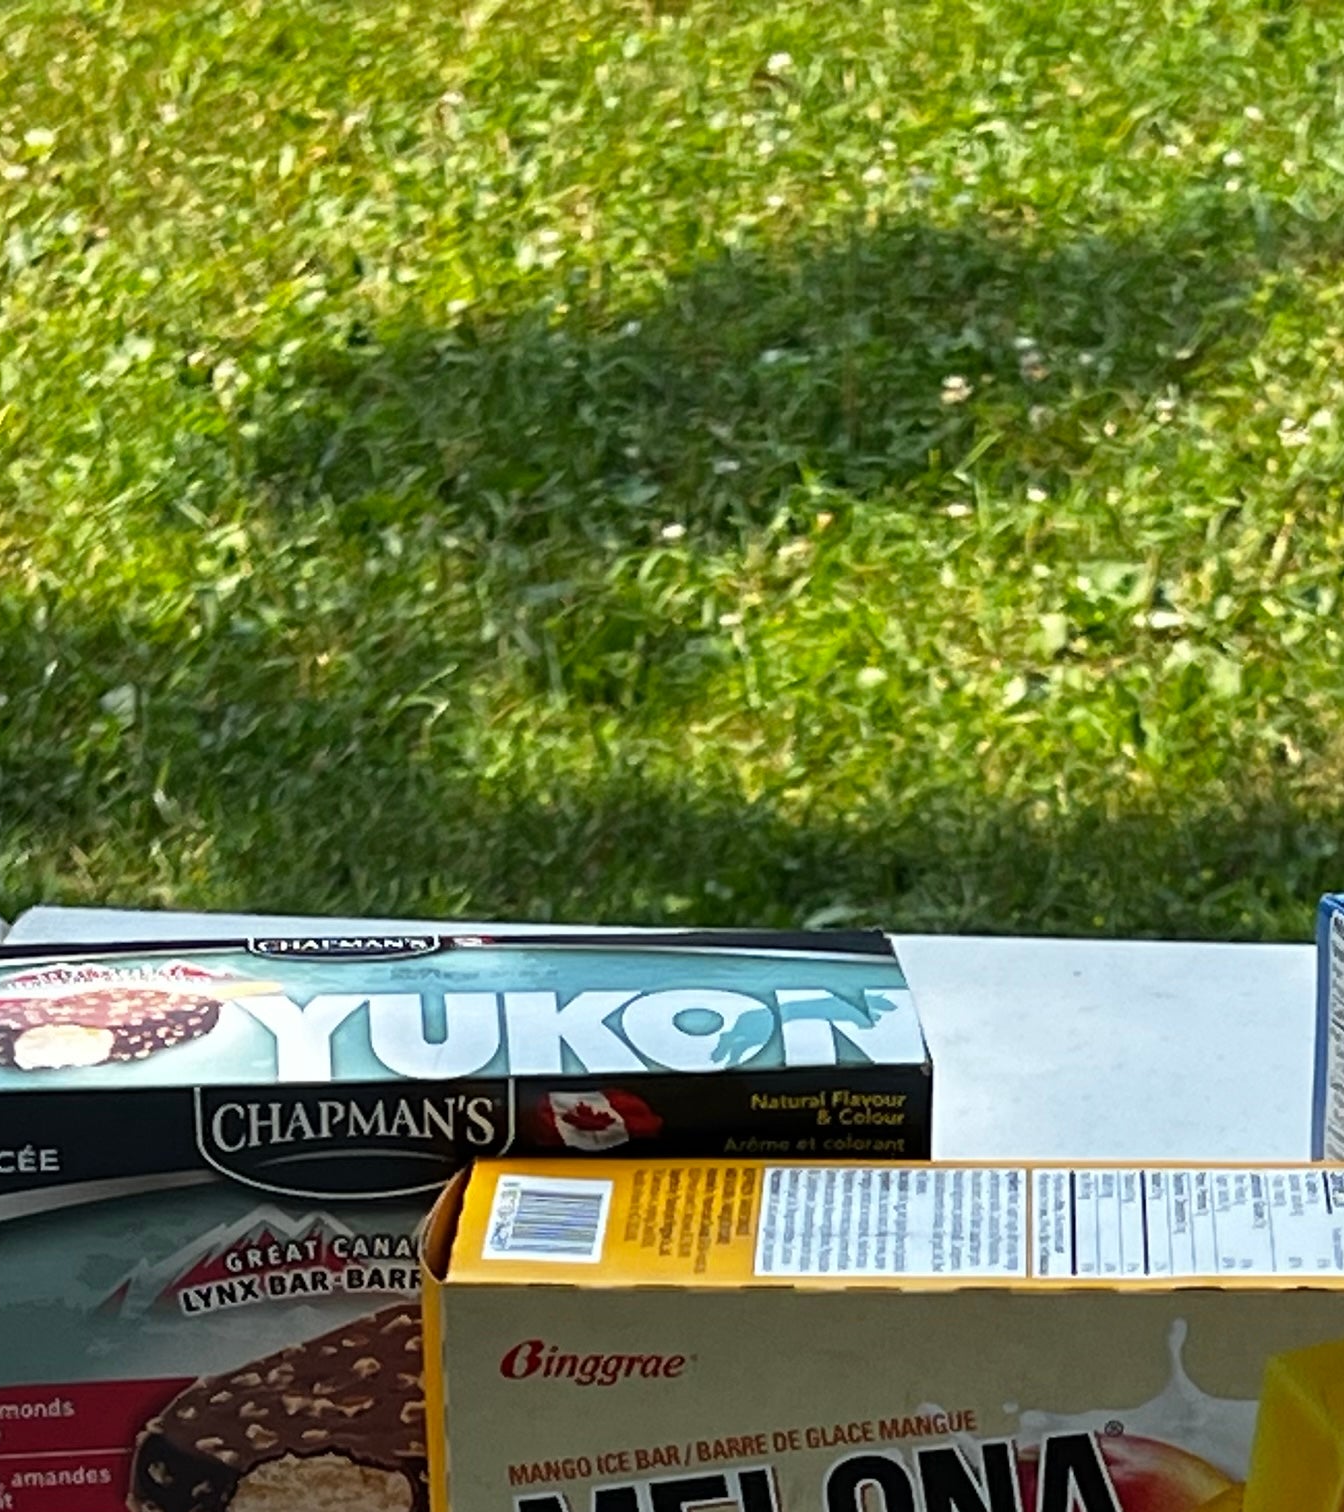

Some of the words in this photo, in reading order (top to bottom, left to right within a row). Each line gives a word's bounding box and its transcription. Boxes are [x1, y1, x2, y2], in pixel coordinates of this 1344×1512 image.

[232, 988, 929, 1082] YUKON
[750, 1090, 827, 1111] Natural
[831, 1088, 907, 1109] Flavour
[816, 1107, 832, 1126] &
[838, 1107, 906, 1126] Colour
[211, 1095, 496, 1153] CHAPMAN'S
[795, 1136, 816, 1151] et
[225, 1239, 319, 1274] GREAT
[333, 1235, 419, 1260] CANA
[181, 1278, 261, 1314] LYNX
[267, 1270, 331, 1297] BAR
[499, 1338, 687, 1387] Binggrae
[506, 1456, 594, 1486] MANGO
[597, 1452, 633, 1477] ICE
[635, 1444, 681, 1471] BAR
[695, 1433, 770, 1463] BARRE
[772, 1429, 802, 1454] DE
[805, 1420, 875, 1449] GLACE
[877, 1409, 978, 1440] MANGUE
[10, 1465, 113, 1487] amandes
